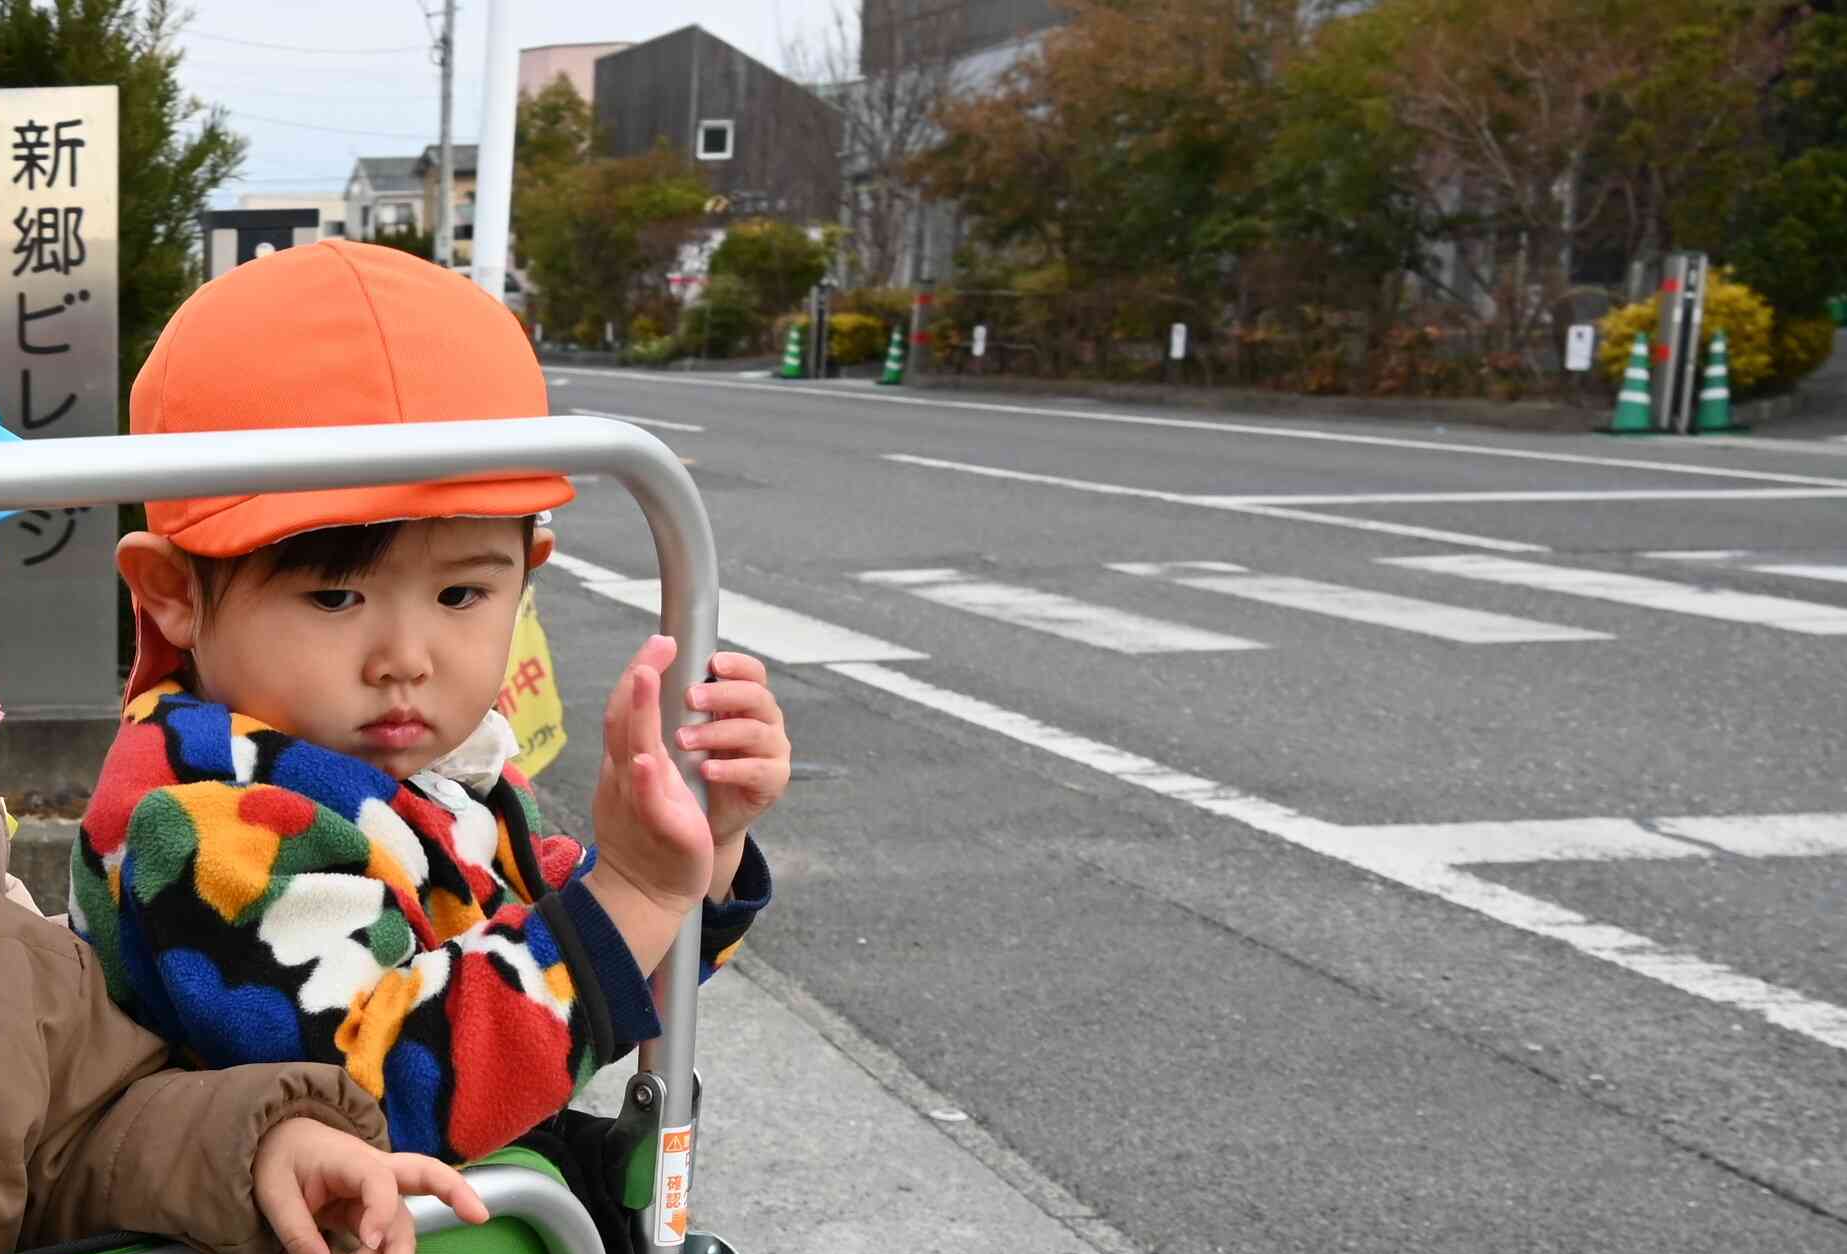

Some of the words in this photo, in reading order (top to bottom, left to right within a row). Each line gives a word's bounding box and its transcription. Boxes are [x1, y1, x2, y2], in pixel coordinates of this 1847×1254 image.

[13, 119, 91, 567] 新郷ビレジ
